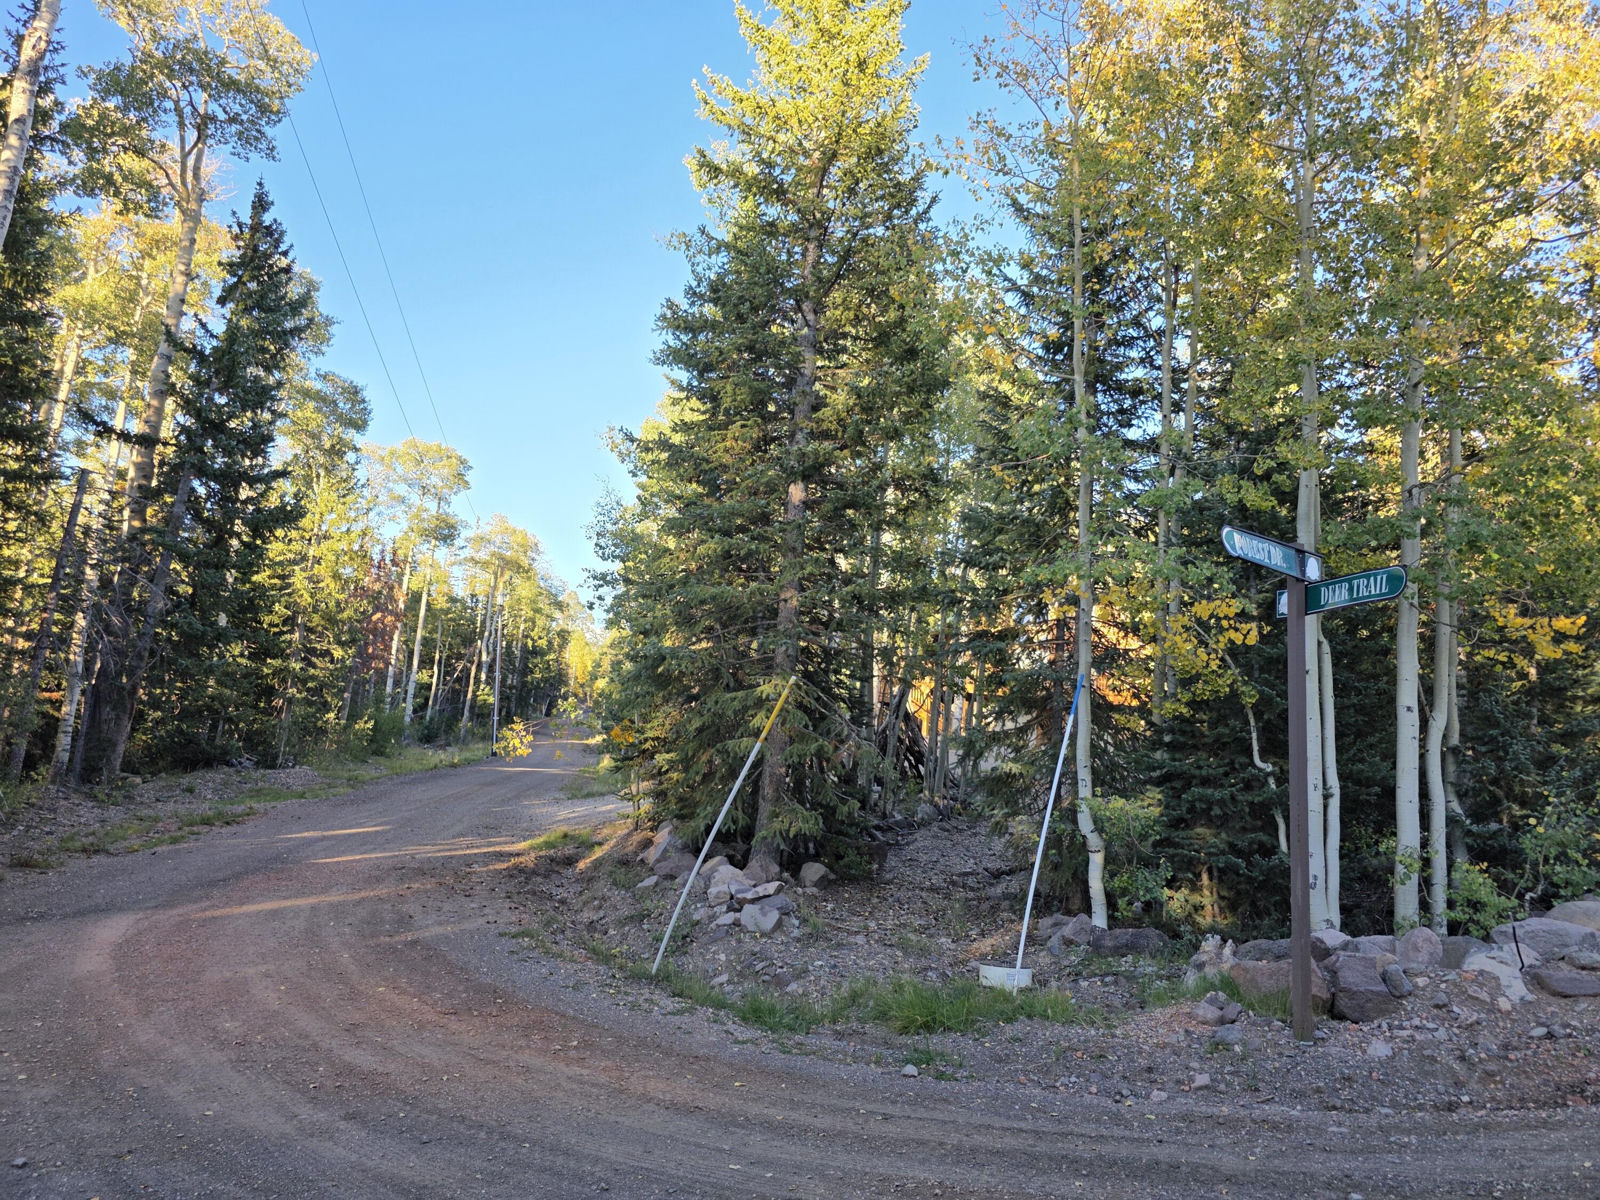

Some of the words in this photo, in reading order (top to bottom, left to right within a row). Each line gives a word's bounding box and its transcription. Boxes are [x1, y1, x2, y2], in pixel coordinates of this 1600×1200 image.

[1233, 533, 1270, 563] FOREST
[1320, 582, 1349, 605] DEER
[1352, 574, 1389, 598] TRAIL
